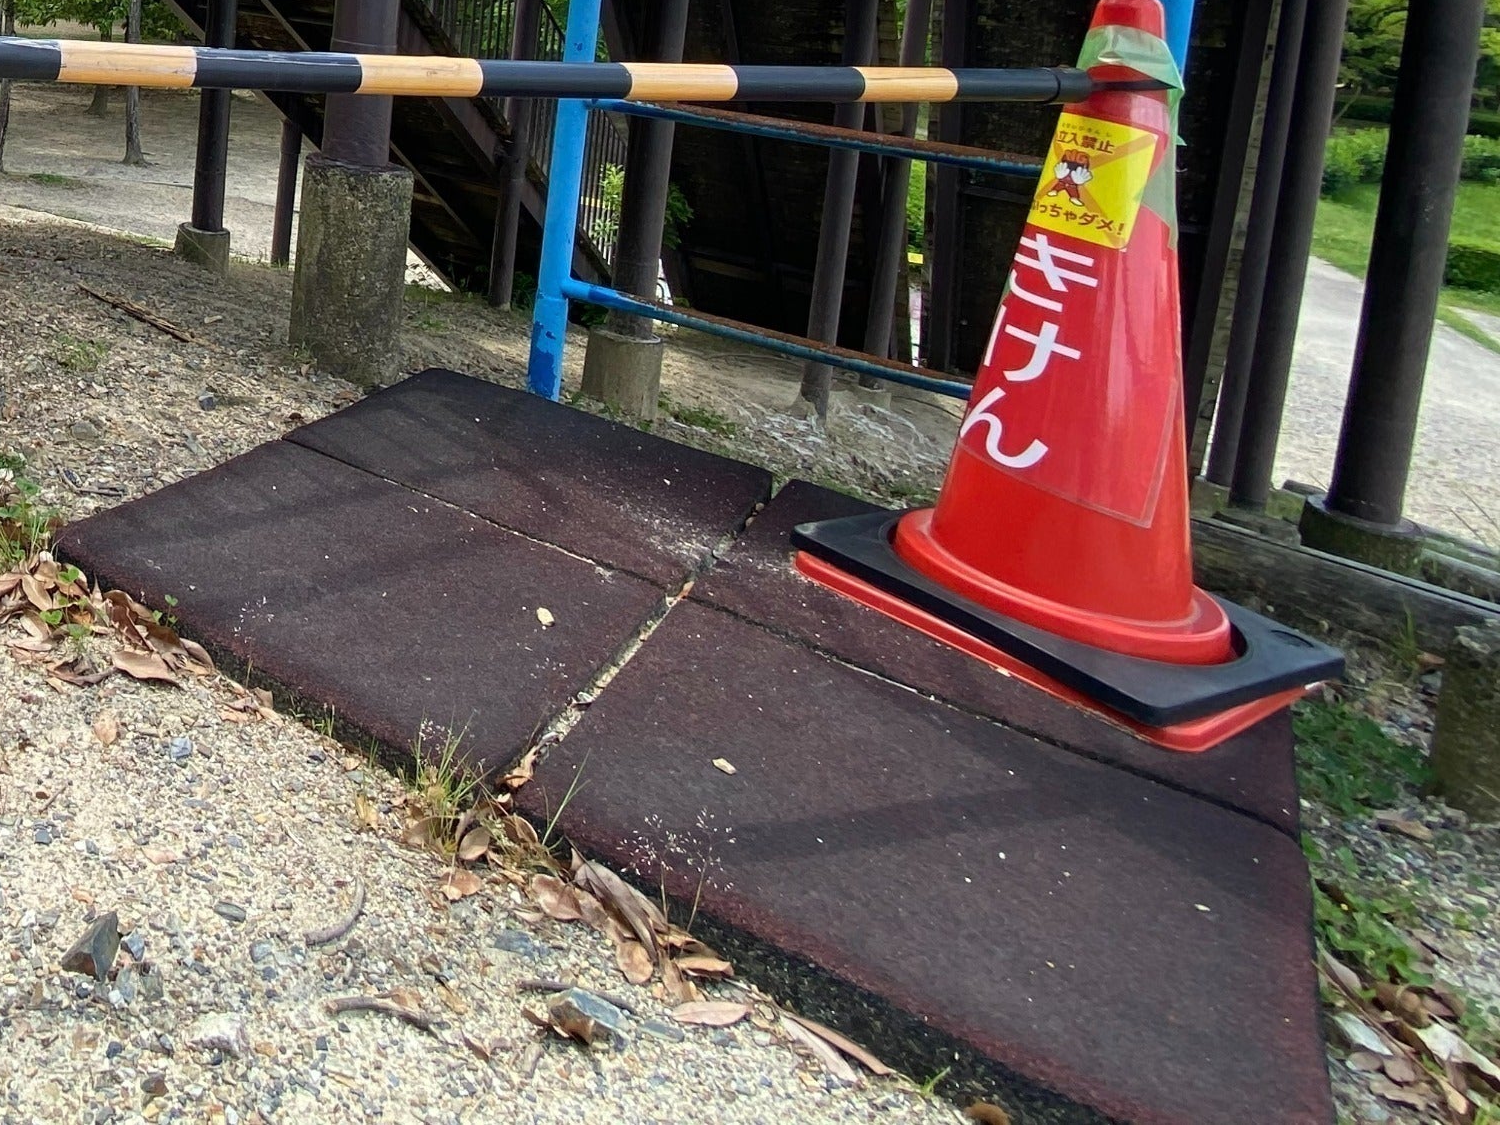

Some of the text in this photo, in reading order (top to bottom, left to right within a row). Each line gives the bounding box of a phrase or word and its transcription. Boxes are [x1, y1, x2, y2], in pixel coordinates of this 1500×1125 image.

[1056, 130, 1115, 154] 立入禁止
[959, 233, 1099, 469] きけん
